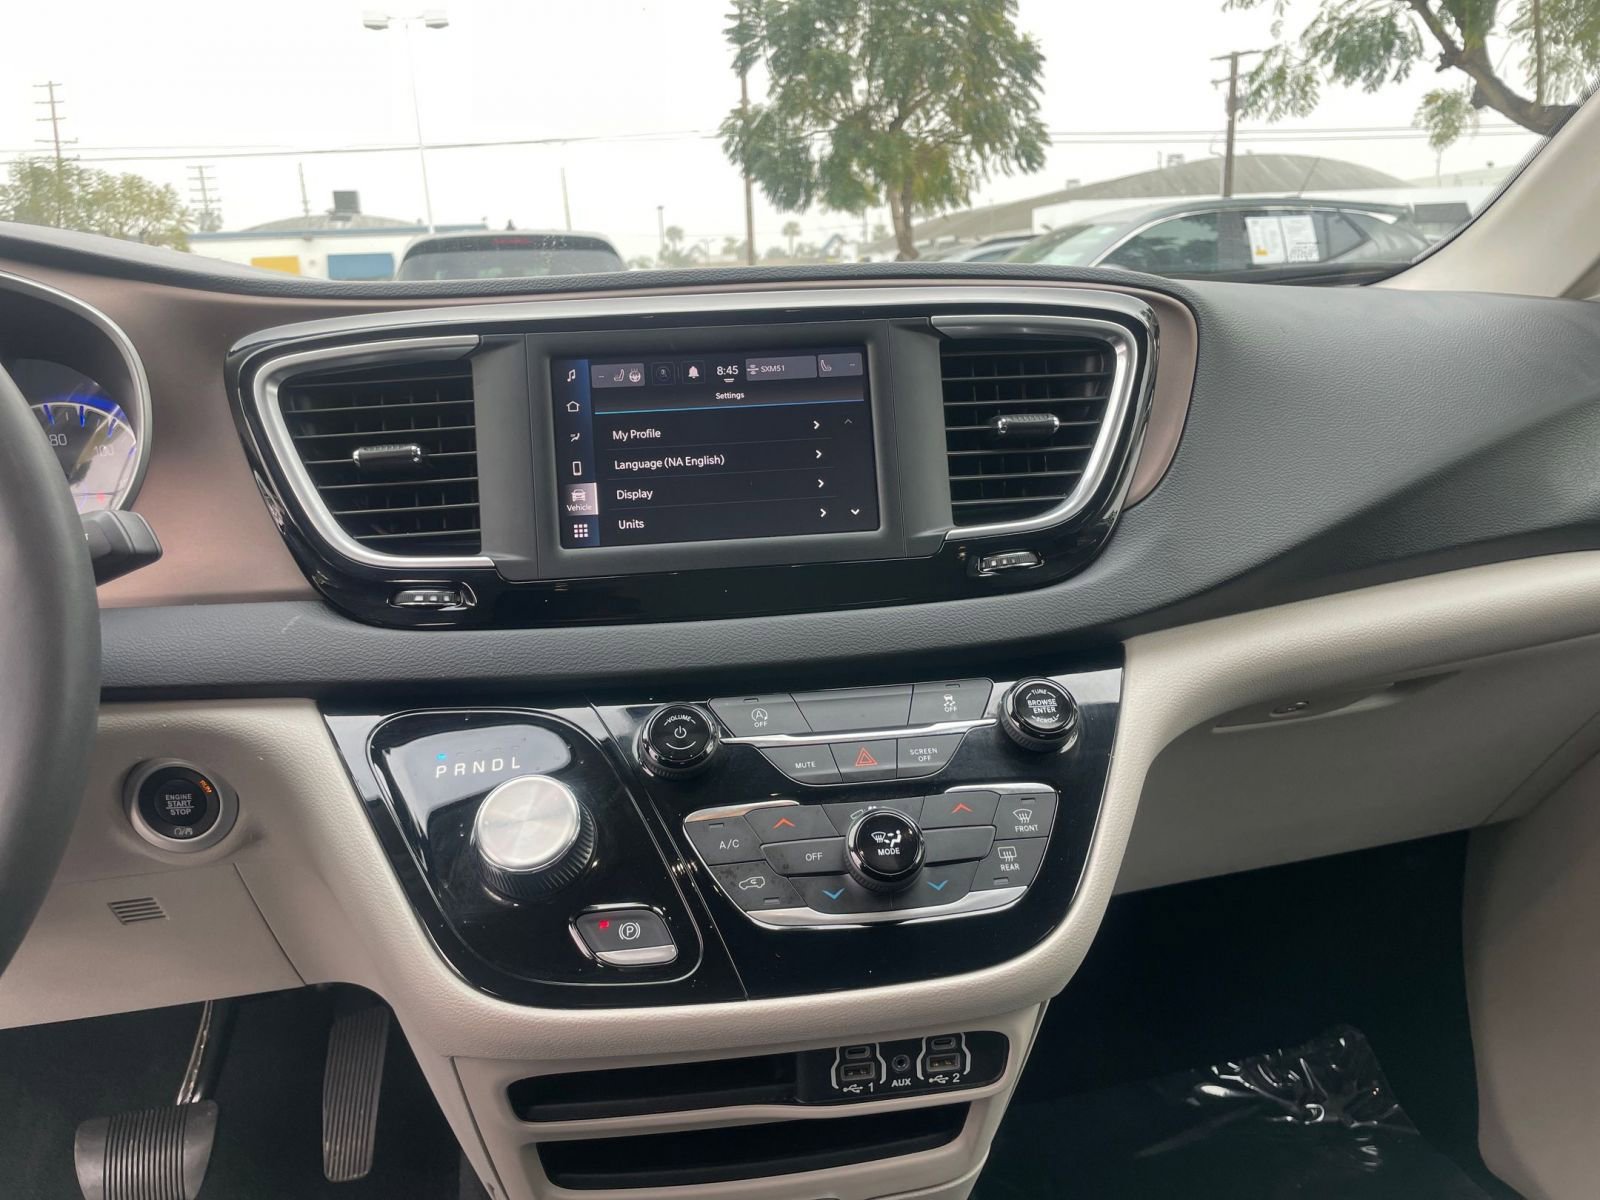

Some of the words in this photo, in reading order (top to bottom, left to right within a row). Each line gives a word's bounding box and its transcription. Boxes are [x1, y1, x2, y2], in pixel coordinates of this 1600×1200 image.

[716, 365, 739, 376] 8:45
[760, 365, 785, 373] SXM51
[715, 392, 745, 401] Settings
[612, 430, 628, 441] My
[630, 428, 662, 440] Profile
[614, 459, 663, 472] Language
[664, 456, 684, 469] (NA
[685, 454, 725, 468] English)
[616, 489, 653, 501] Display
[566, 504, 593, 512] Vehicle
[618, 519, 645, 530] Units
[1028, 698, 1057, 707] BROWSE
[1033, 706, 1057, 714] ENTER
[667, 714, 692, 723] VOLUME
[918, 754, 931, 762] OFF
[795, 761, 816, 769] MUTE
[165, 793, 193, 801] ENGINE
[167, 800, 192, 808] START
[1015, 824, 1039, 832] FRONT
[719, 839, 740, 850] A/C
[877, 847, 901, 856] MODE
[805, 852, 823, 862] OFF
[1000, 862, 1020, 872] REAR
[891, 1078, 912, 1087] AUX
[952, 1073, 960, 1083] 2
